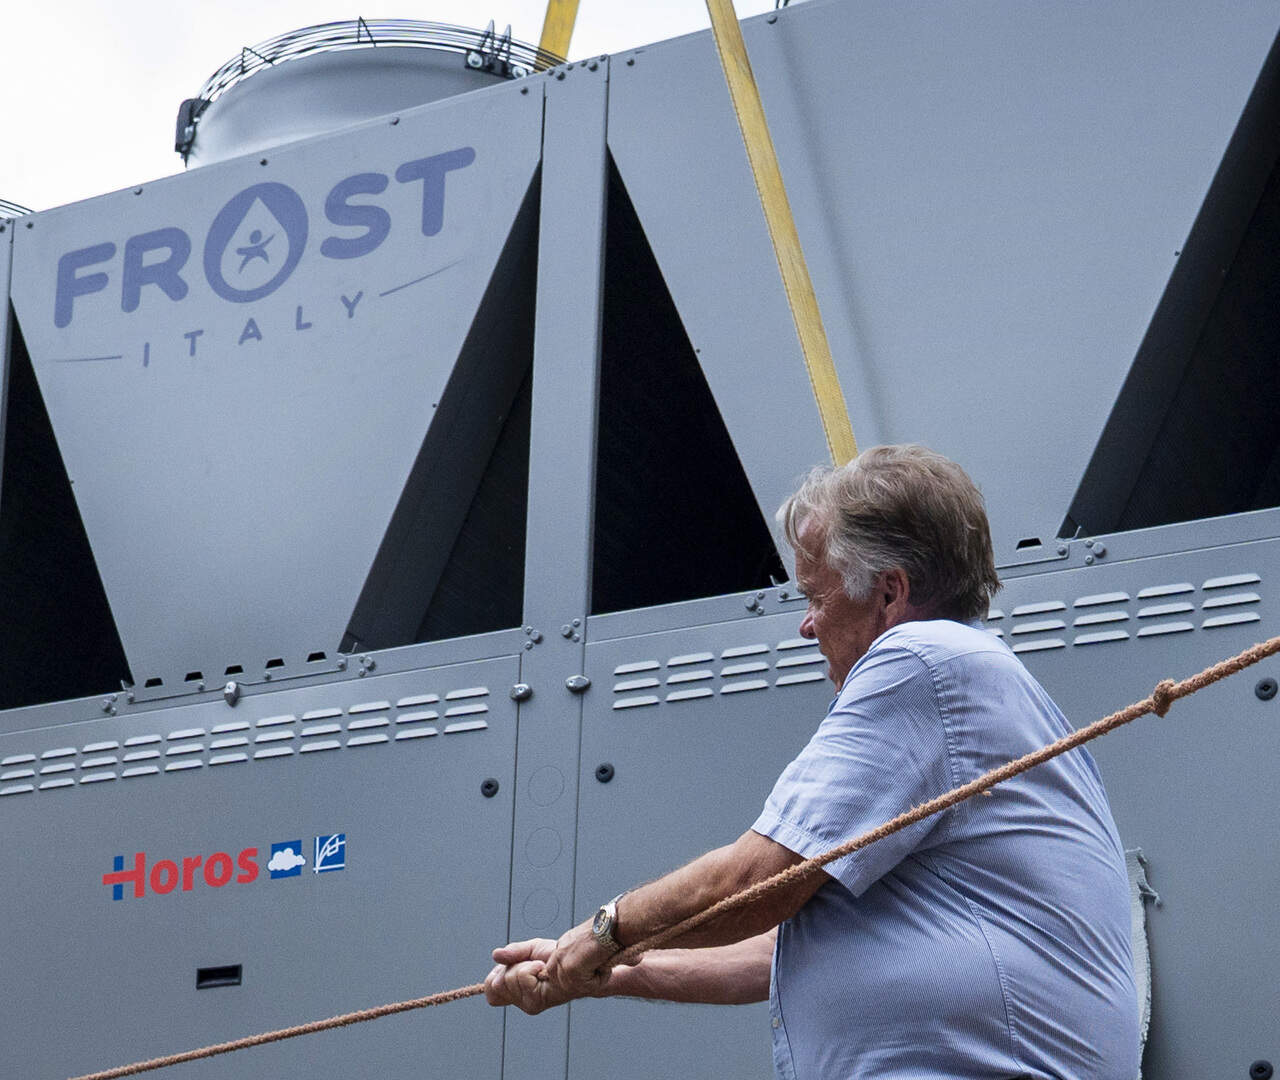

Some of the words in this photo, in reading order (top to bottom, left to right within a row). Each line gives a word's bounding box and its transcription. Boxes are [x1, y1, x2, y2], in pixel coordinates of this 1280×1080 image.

[53, 146, 476, 330] FROST
[143, 290, 364, 368] ITALY
[102, 847, 259, 901] Horos
